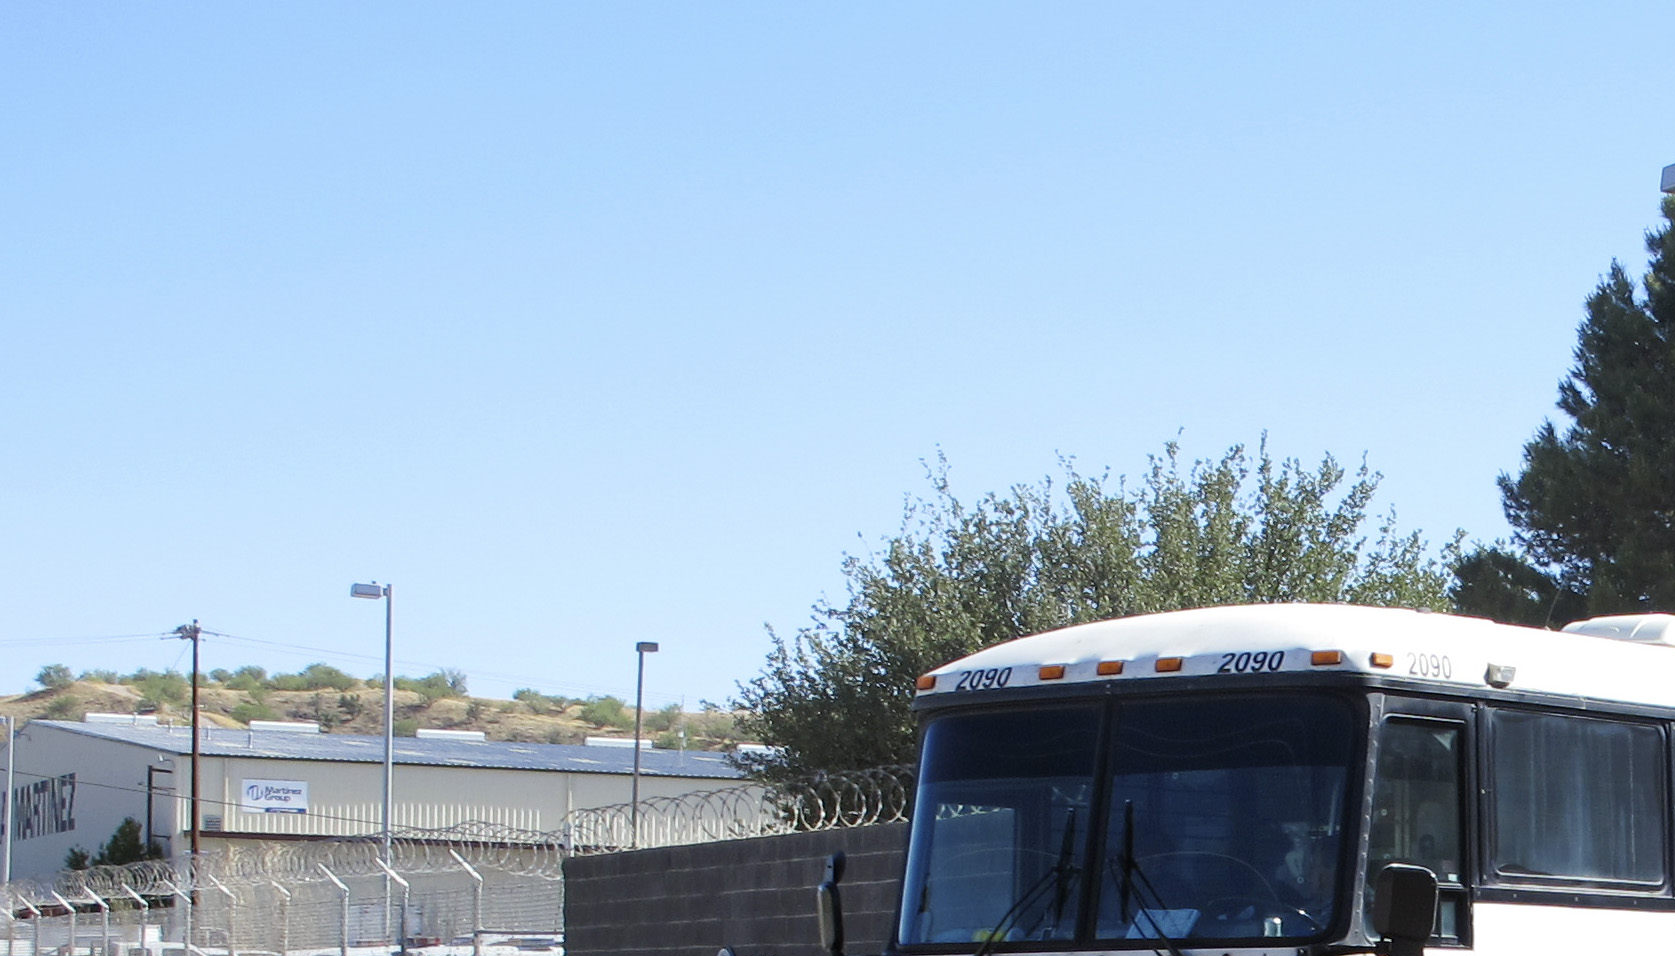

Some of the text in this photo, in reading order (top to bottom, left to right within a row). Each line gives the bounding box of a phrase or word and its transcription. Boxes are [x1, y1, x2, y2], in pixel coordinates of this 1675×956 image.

[1217, 651, 1284, 675] 2090
[1407, 652, 1452, 679] 2090
[956, 666, 1013, 691] 2090
[265, 786, 302, 795] Martinez
[265, 794, 291, 802] Group
[14, 772, 76, 840] MARTINEZ
